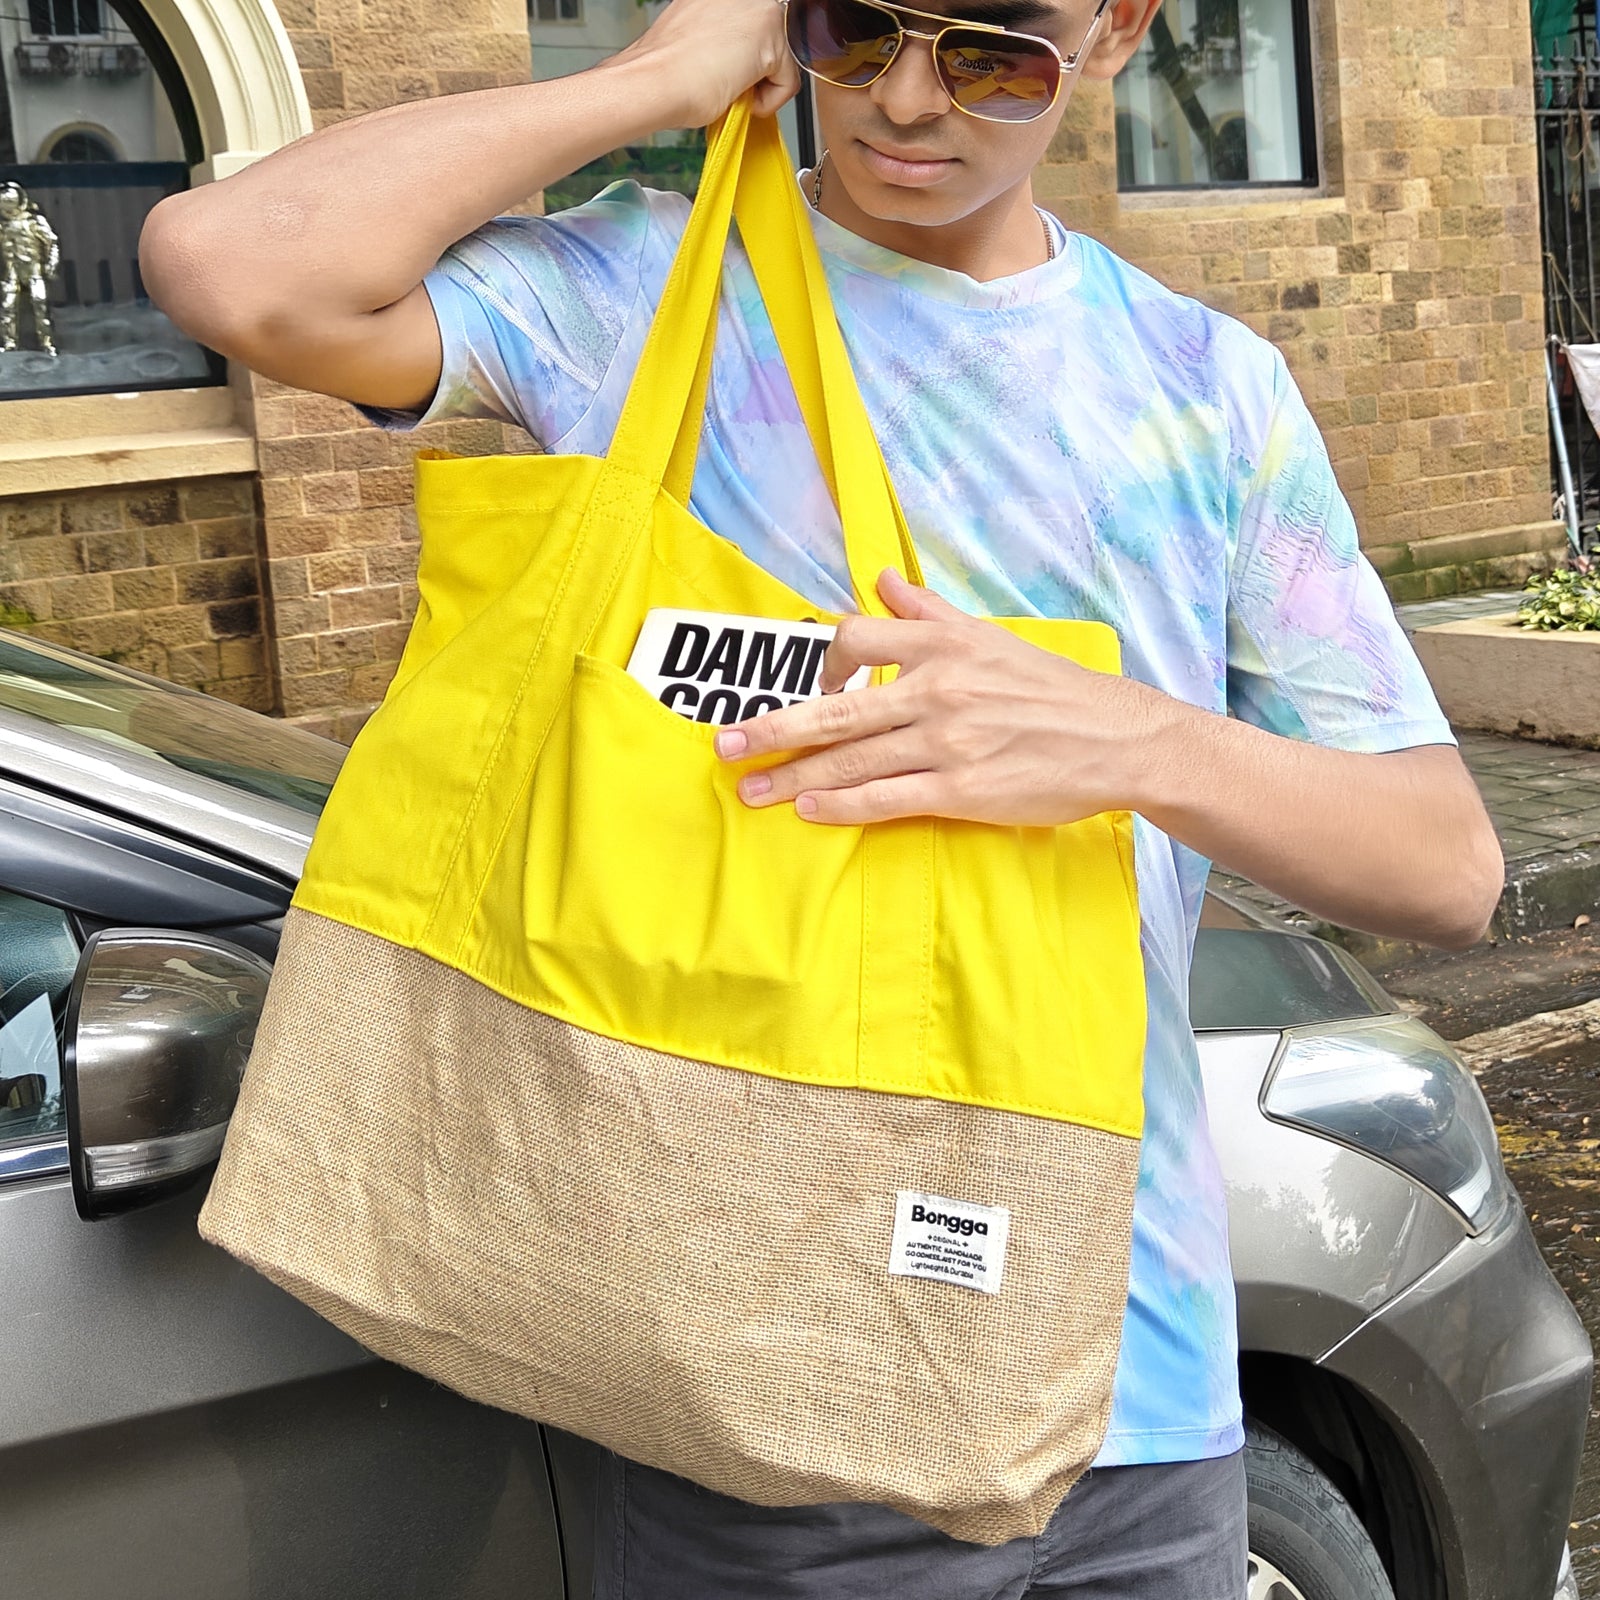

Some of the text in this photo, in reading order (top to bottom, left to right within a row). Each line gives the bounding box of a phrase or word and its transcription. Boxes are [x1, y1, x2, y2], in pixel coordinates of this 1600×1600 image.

[659, 682, 806, 726] GO
[911, 1204, 988, 1236] Bongga
[906, 1241, 942, 1253] AUTHENTIC
[957, 1259, 971, 1268] FOR
[972, 1262, 987, 1272] YOU
